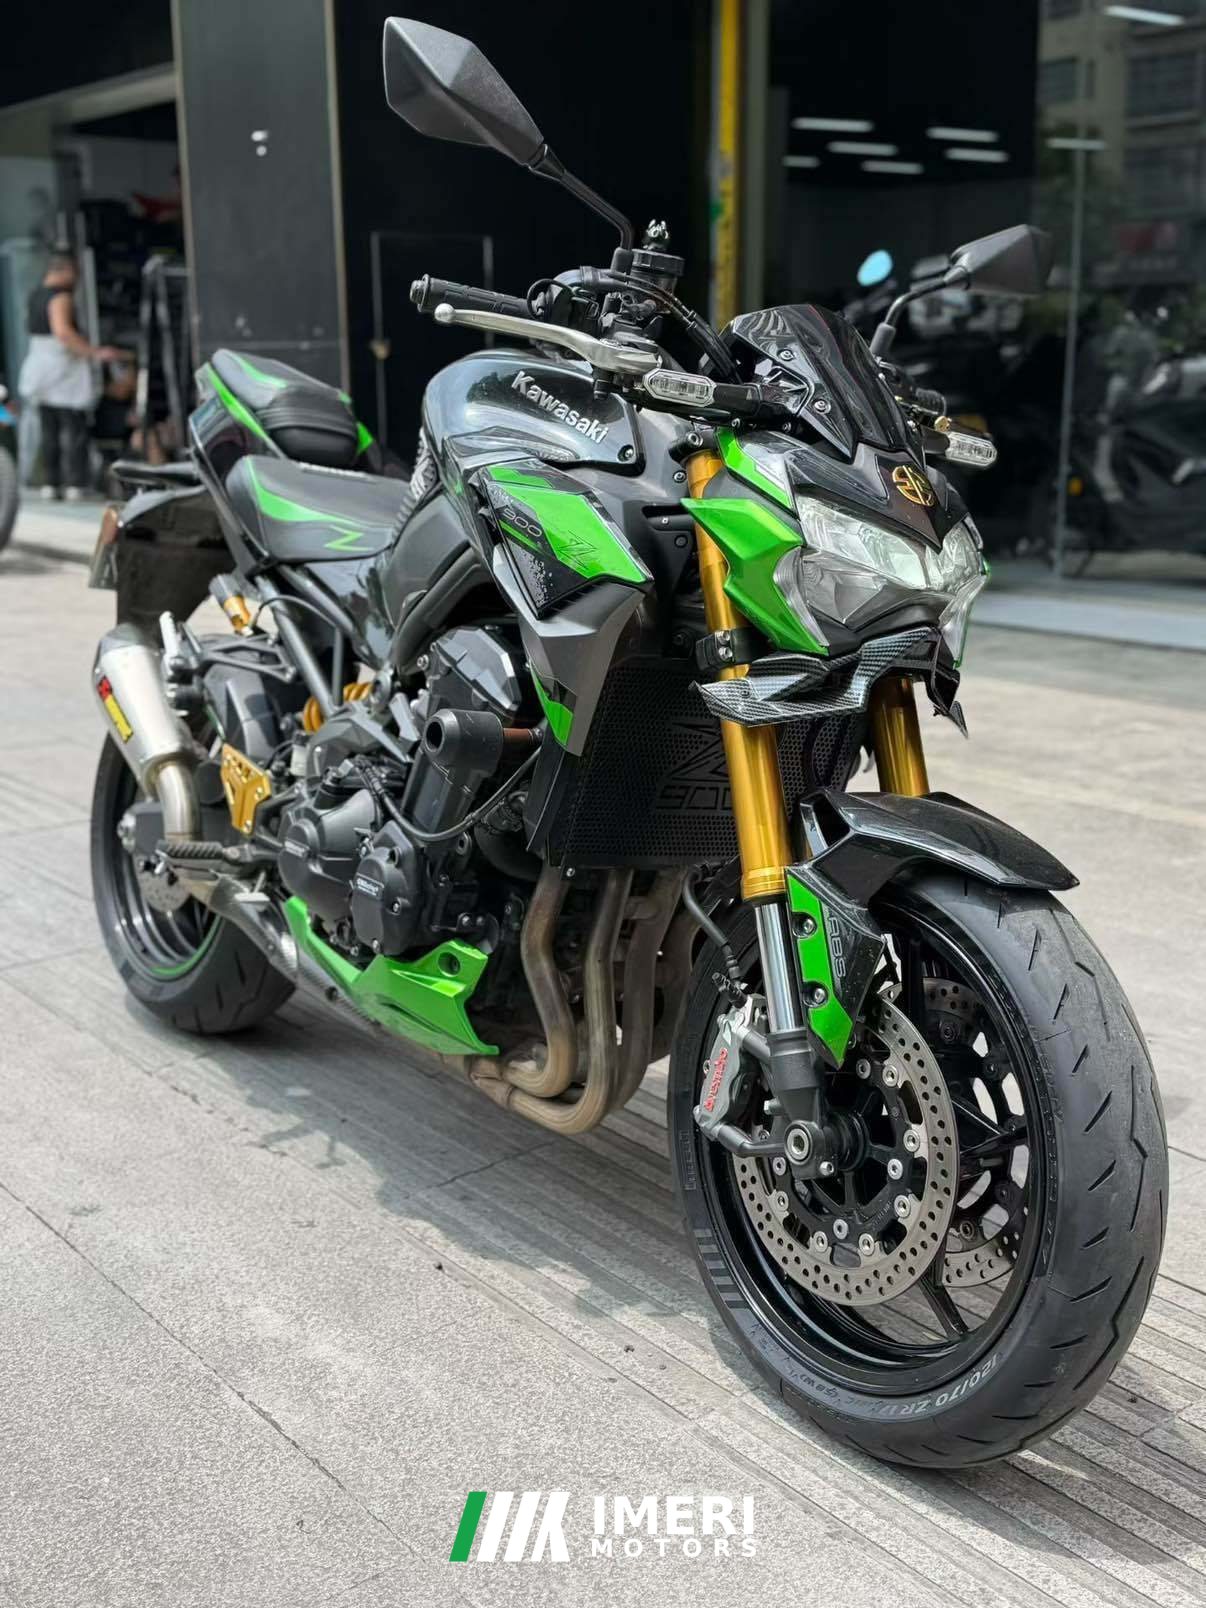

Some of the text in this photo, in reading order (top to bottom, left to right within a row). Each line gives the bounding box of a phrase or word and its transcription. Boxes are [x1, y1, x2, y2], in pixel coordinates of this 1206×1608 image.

[510, 369, 609, 445] Kawasaki
[502, 507, 543, 538] 900
[828, 916, 847, 978] ABS
[934, 1353, 998, 1407] 120/70
